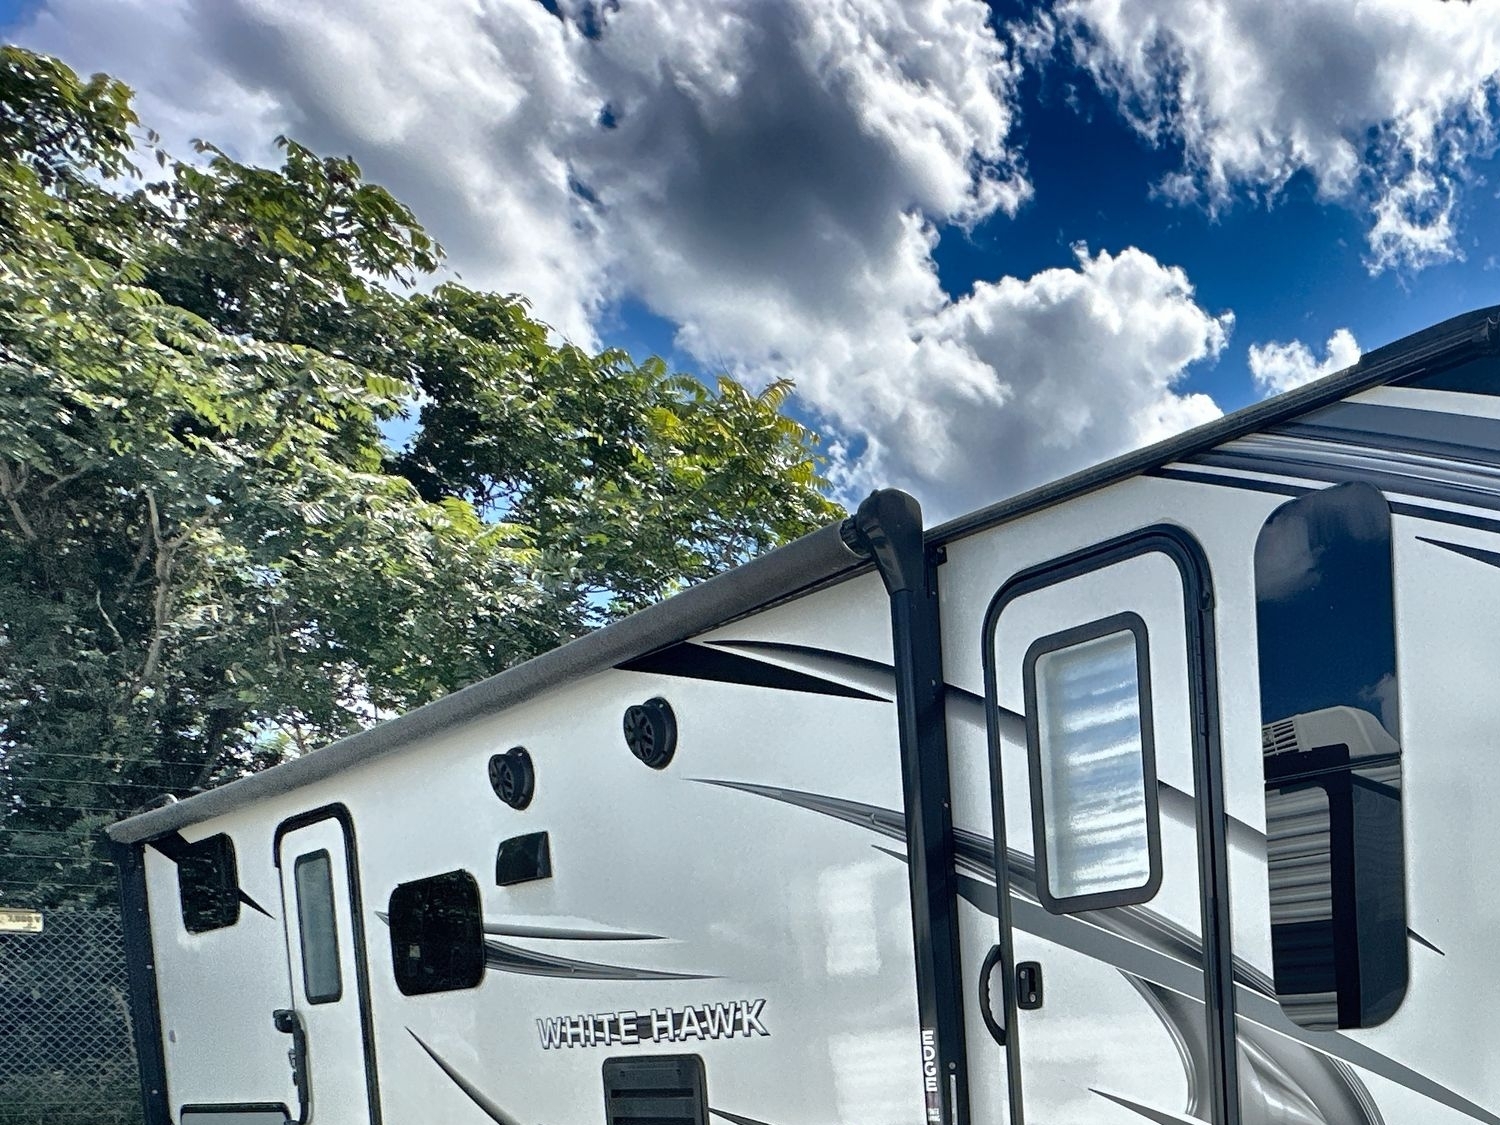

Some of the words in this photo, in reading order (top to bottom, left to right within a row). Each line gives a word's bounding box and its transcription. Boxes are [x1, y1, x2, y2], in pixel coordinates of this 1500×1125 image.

[536, 1010, 640, 1049] WHITE
[650, 998, 771, 1043] HAWK
[922, 1029, 938, 1092] EDGE
